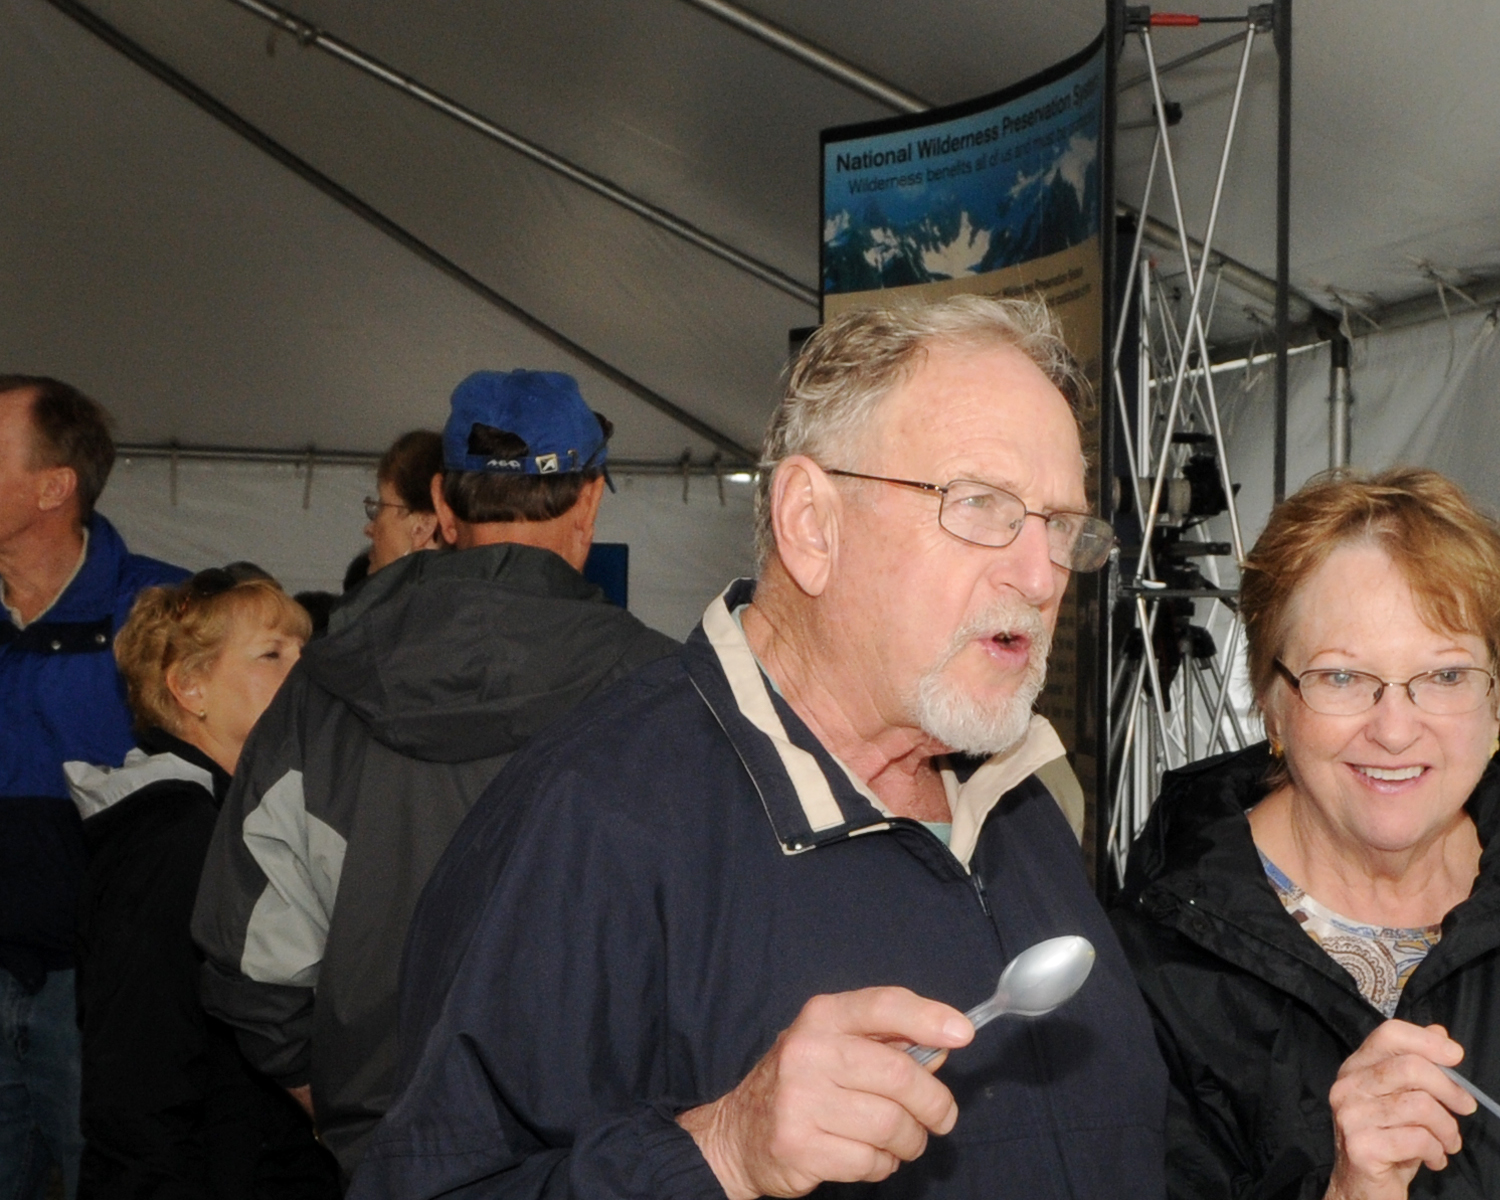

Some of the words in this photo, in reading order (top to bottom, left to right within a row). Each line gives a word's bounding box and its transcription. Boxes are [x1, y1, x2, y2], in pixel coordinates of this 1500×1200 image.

[836, 141, 912, 173] National
[916, 123, 999, 159] Wilderness
[1001, 93, 1071, 136] Preservation
[849, 171, 923, 194] Wilderness
[926, 158, 973, 182] benefits
